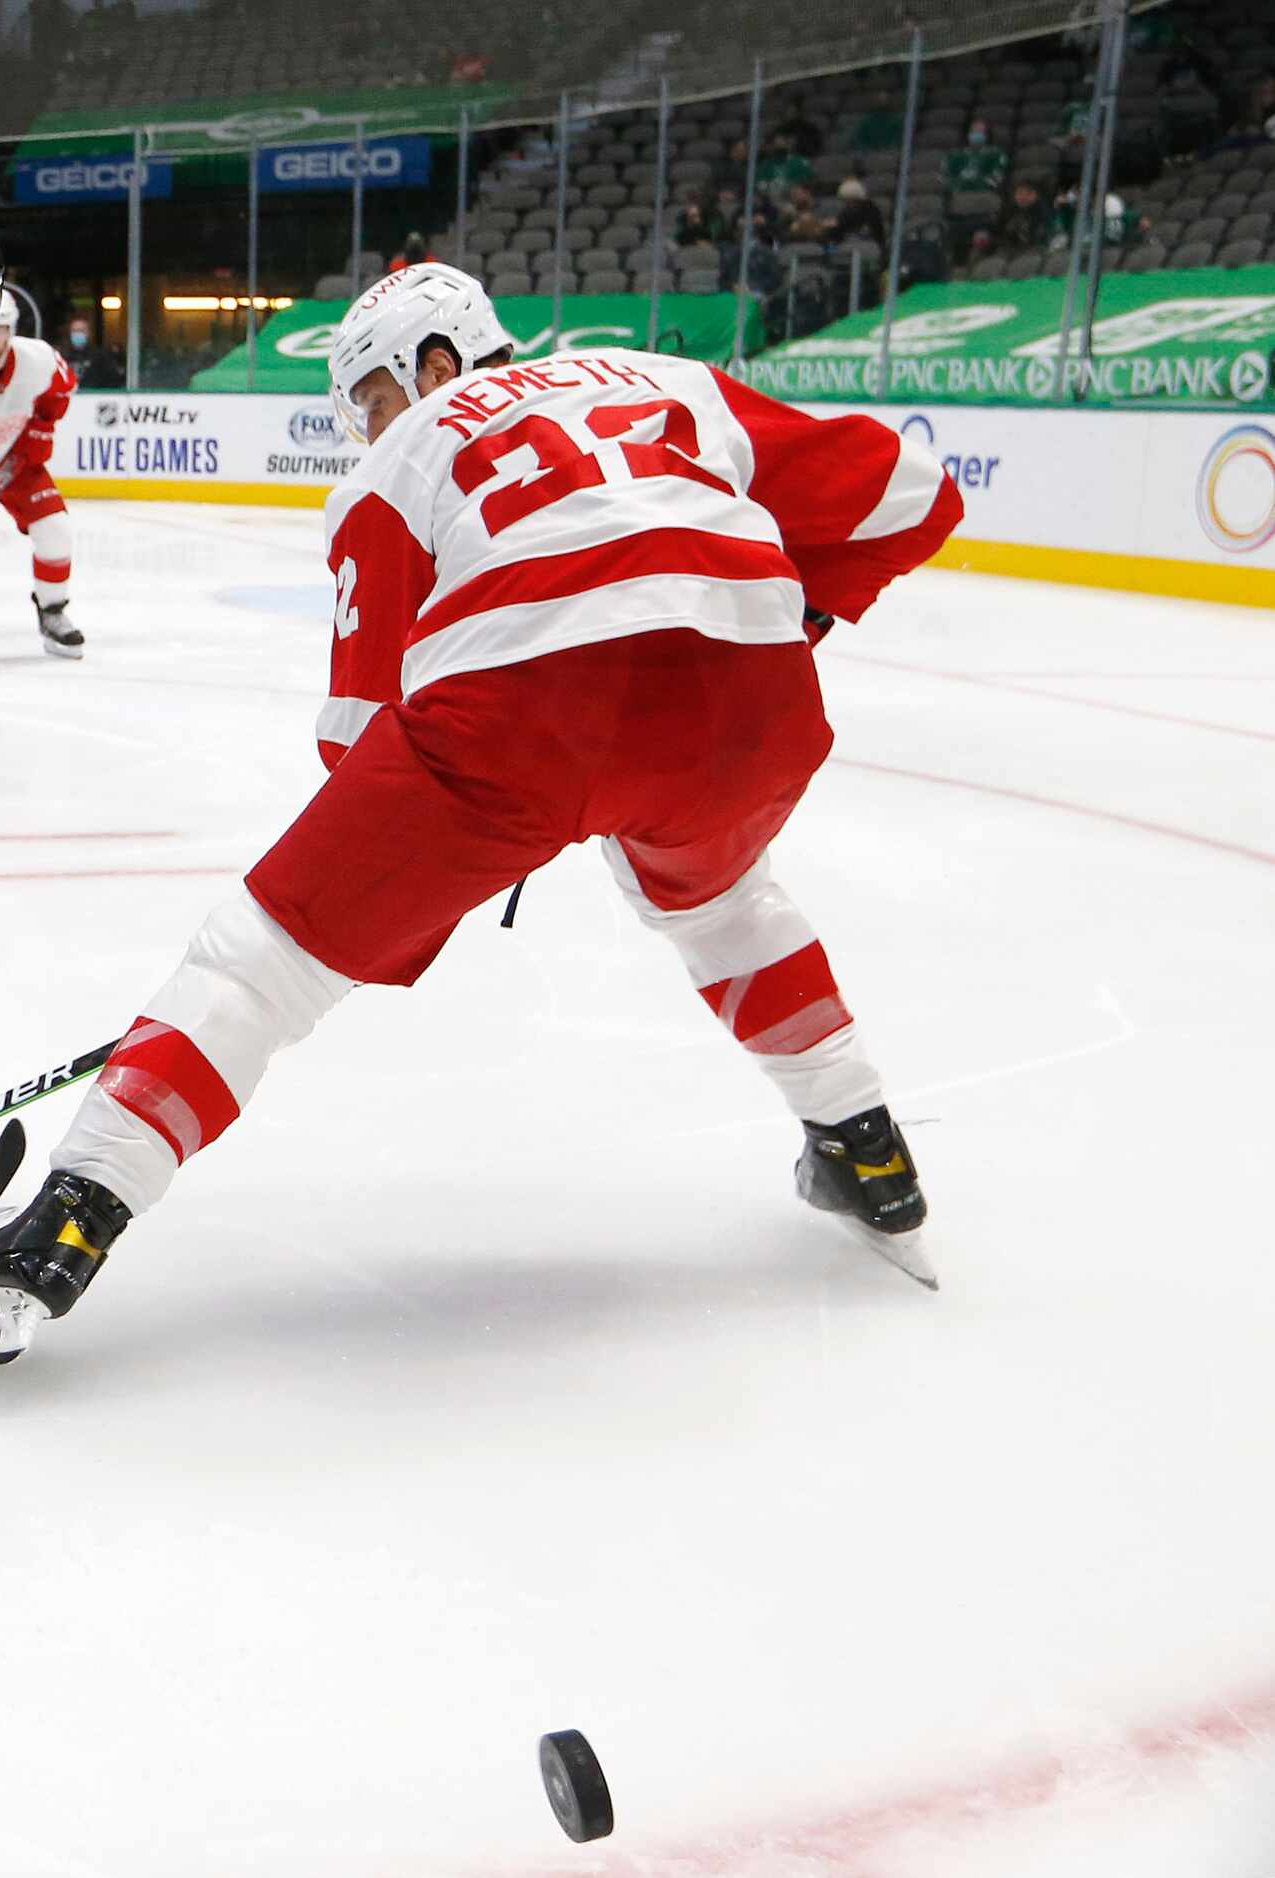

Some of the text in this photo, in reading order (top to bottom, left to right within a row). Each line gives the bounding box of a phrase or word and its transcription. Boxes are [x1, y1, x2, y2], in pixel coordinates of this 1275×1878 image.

[35, 160, 149, 193] GEICO
[273, 147, 402, 181] GEICO
[437, 359, 661, 440] NEMETH
[301, 415, 335, 433] FOX
[76, 437, 219, 474] LIVE GAMES
[452, 399, 737, 538] 22
